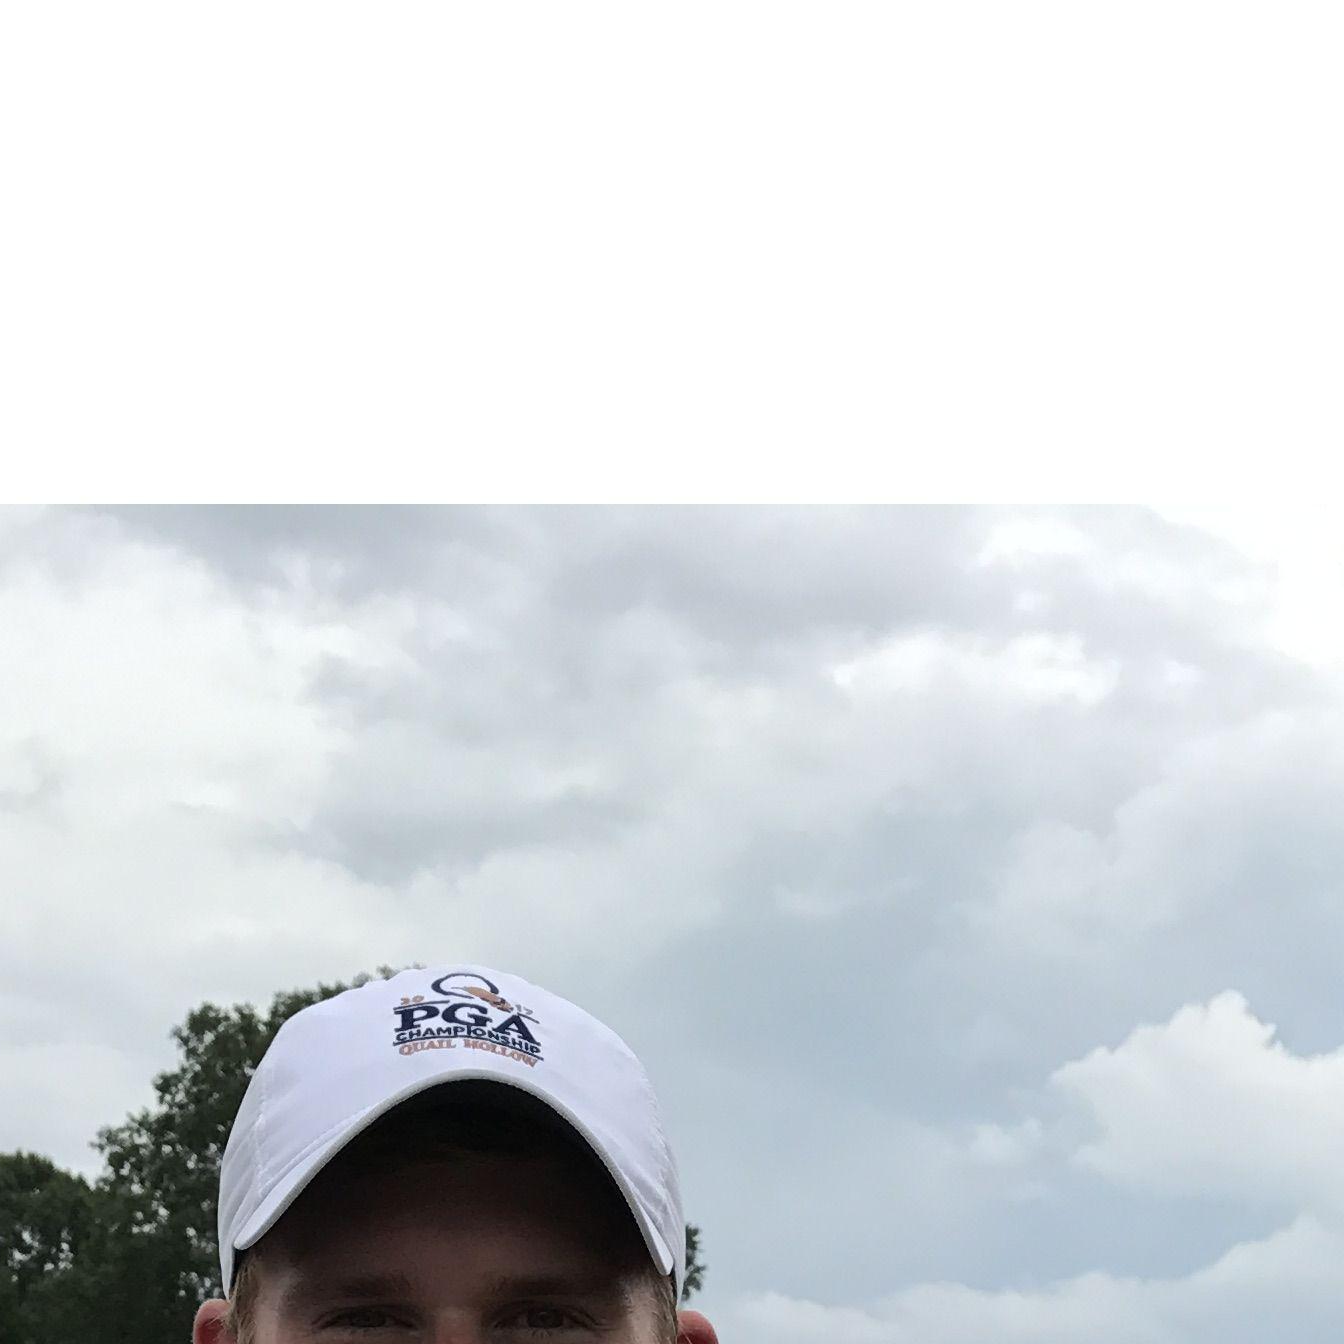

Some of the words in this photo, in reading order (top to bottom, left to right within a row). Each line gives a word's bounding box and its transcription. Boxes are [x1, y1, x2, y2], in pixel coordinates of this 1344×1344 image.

[394, 1003, 541, 1046] PGA
[395, 1025, 541, 1054] CHAMPIONSHIP
[399, 1038, 456, 1056] QUAIL
[463, 1038, 537, 1068] HOLLOW
